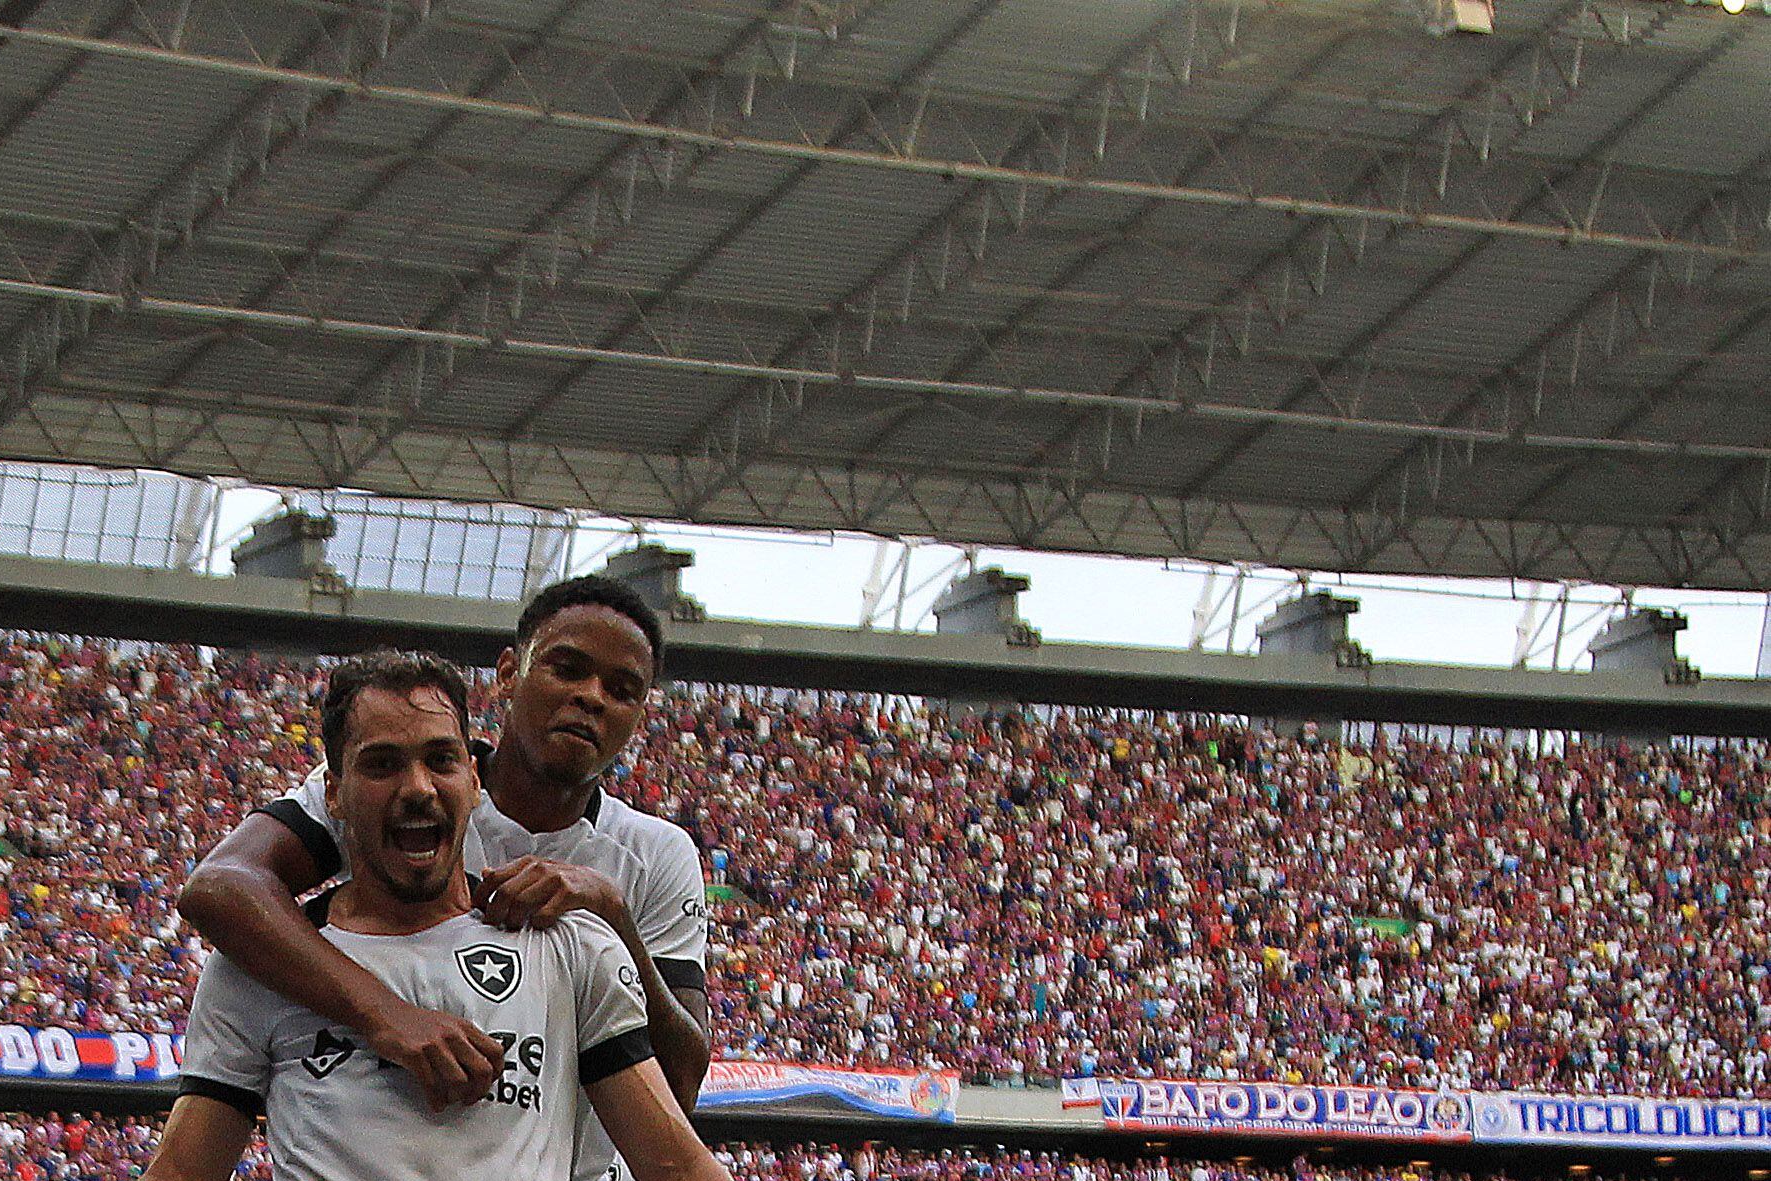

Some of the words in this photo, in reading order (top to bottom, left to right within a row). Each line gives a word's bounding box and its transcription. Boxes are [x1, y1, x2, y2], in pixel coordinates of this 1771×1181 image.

[1140, 1082, 1250, 1119] BAFO
[1257, 1085, 1317, 1121] DO
[1511, 1099, 1771, 1137] TRICOLOUCO
